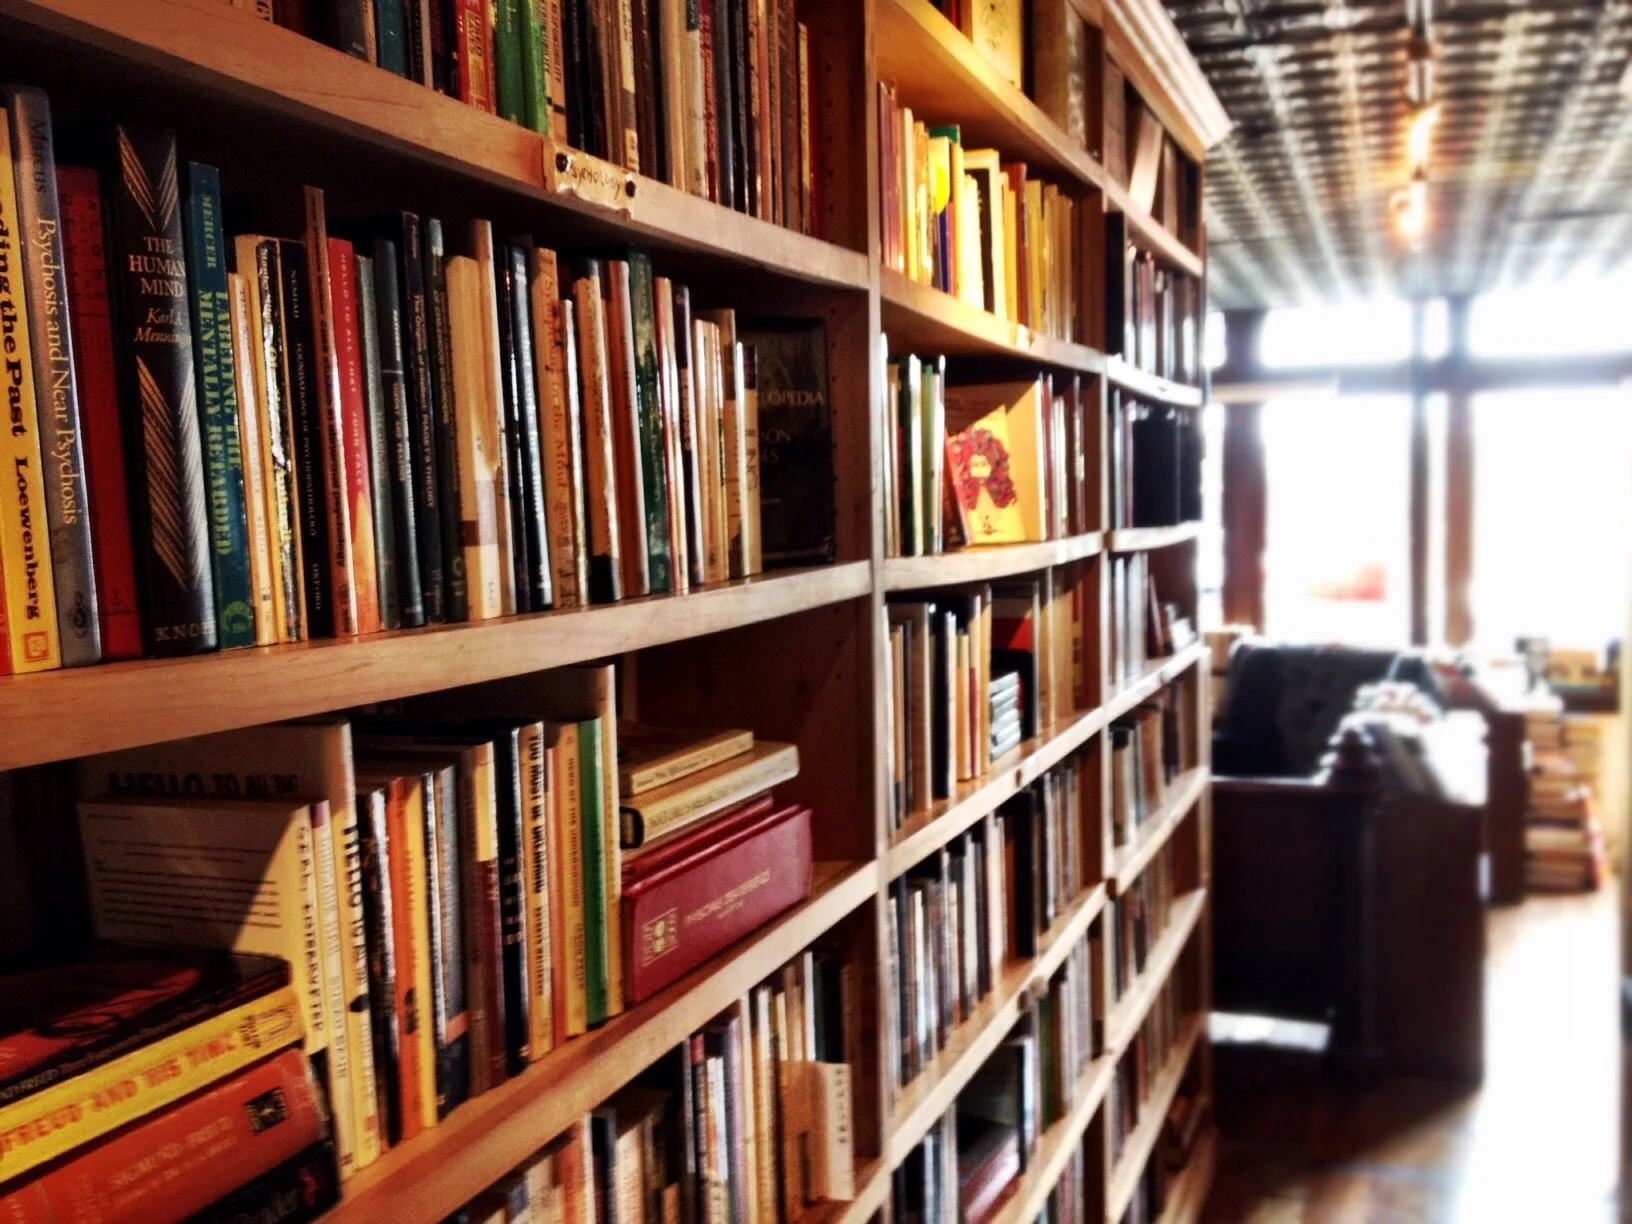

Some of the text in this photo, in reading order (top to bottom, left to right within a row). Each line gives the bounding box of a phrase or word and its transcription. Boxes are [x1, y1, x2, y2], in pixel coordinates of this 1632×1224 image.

[474, 16, 483, 56] USED
[29, 119, 48, 193] Marcus
[144, 237, 174, 254] THE
[202, 195, 216, 268] MERCER
[32, 218, 62, 315] Psychosis
[128, 255, 186, 277] HUMAN
[141, 278, 183, 297] MIND
[1, 300, 18, 353] the
[145, 308, 173, 325] Karl
[414, 295, 422, 313] The
[433, 291, 440, 304] OF
[47, 321, 68, 361] and
[414, 315, 424, 352] Origins
[434, 306, 445, 364] CHILDHOOD
[6, 358, 27, 437] Past
[52, 369, 71, 422] Near
[215, 291, 241, 469] LABELING THE
[341, 254, 362, 486] HELLO TO ALL THAT JOHN FALK
[438, 367, 449, 424] DISORDERS
[199, 289, 232, 555] MENTALLY RETARDED
[290, 270, 321, 610] NEMIAH FOUNDATIONS OF PSYCHOPATHOLOGY OXFORD
[392, 383, 401, 415] THEORY
[397, 443, 405, 481] PRACTICE
[51, 428, 82, 524] Psychosis
[326, 422, 341, 489] abnormal
[555, 439, 568, 488] Mind
[425, 465, 434, 508] THEORY
[15, 456, 41, 620] Loewenberg
[330, 491, 346, 567] psychology
[568, 758, 576, 786] HERO
[569, 789, 576, 802] OF
[528, 735, 545, 894] YOU MUST BE DREAMING
[569, 807, 577, 825] THE
[343, 825, 363, 908] HELLO
[570, 828, 580, 908] UNDERGROUND
[0, 1102, 82, 1159] FREUD
[89, 1078, 138, 1113] AND
